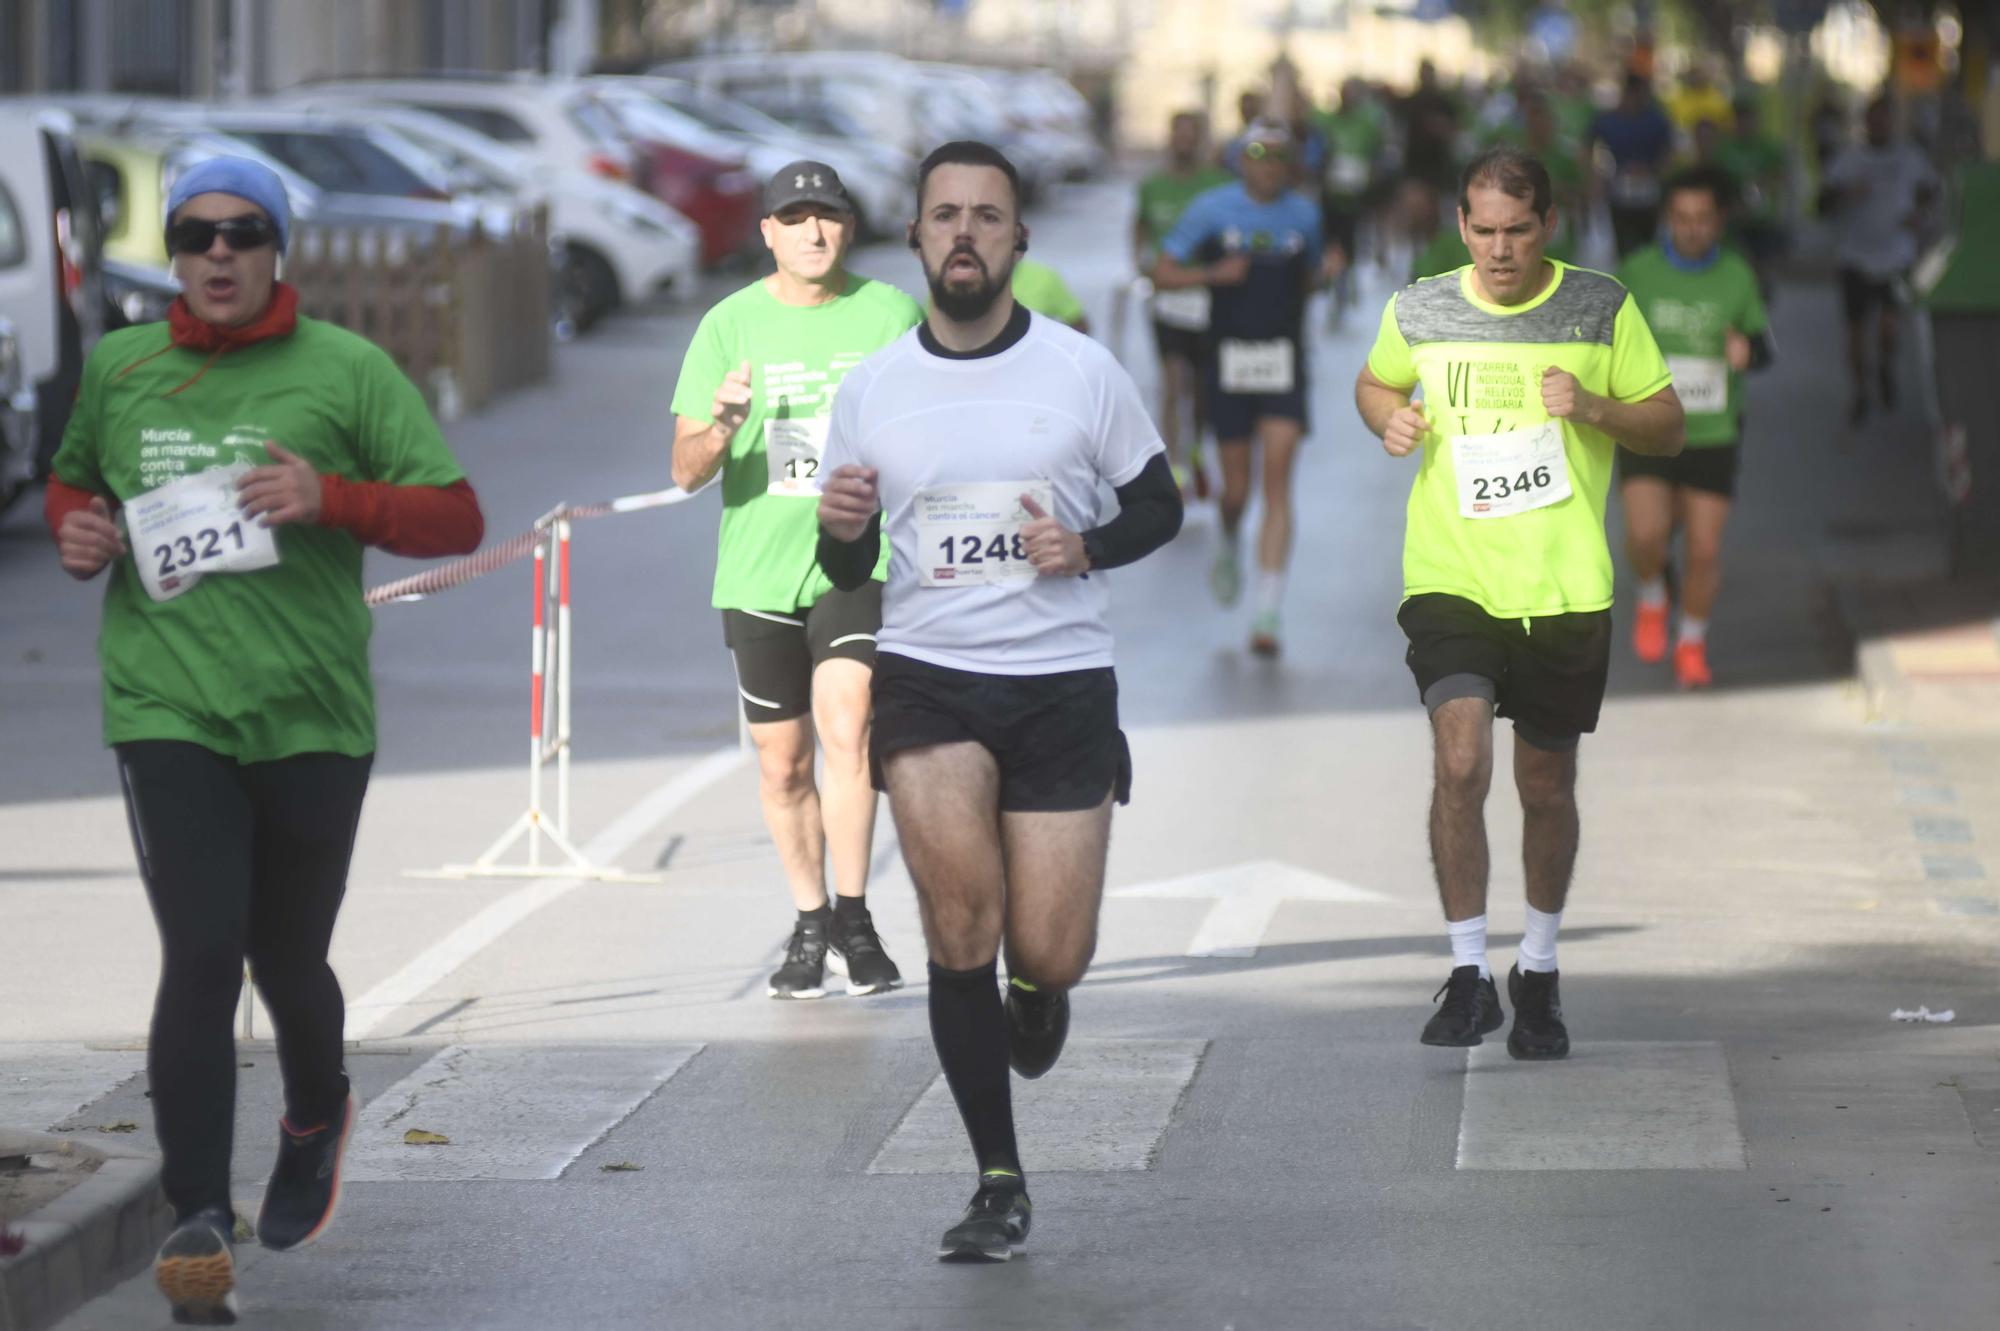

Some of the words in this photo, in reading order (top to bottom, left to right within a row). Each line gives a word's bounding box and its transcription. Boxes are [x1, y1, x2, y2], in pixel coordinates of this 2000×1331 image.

[1476, 362, 1518, 374] CARRERA
[1475, 375, 1526, 387] INDIVIDUAL
[1485, 387, 1526, 399] RELEVOS
[1475, 398, 1523, 410] SOLIDARIA
[141, 429, 192, 443] Murcia
[140, 446, 158, 458] en
[161, 443, 217, 458] marcha
[140, 458, 185, 473] contra
[141, 474, 155, 487] el
[1472, 465, 1551, 501] 2346
[153, 521, 245, 577] 2321
[939, 533, 1028, 564] 1248
